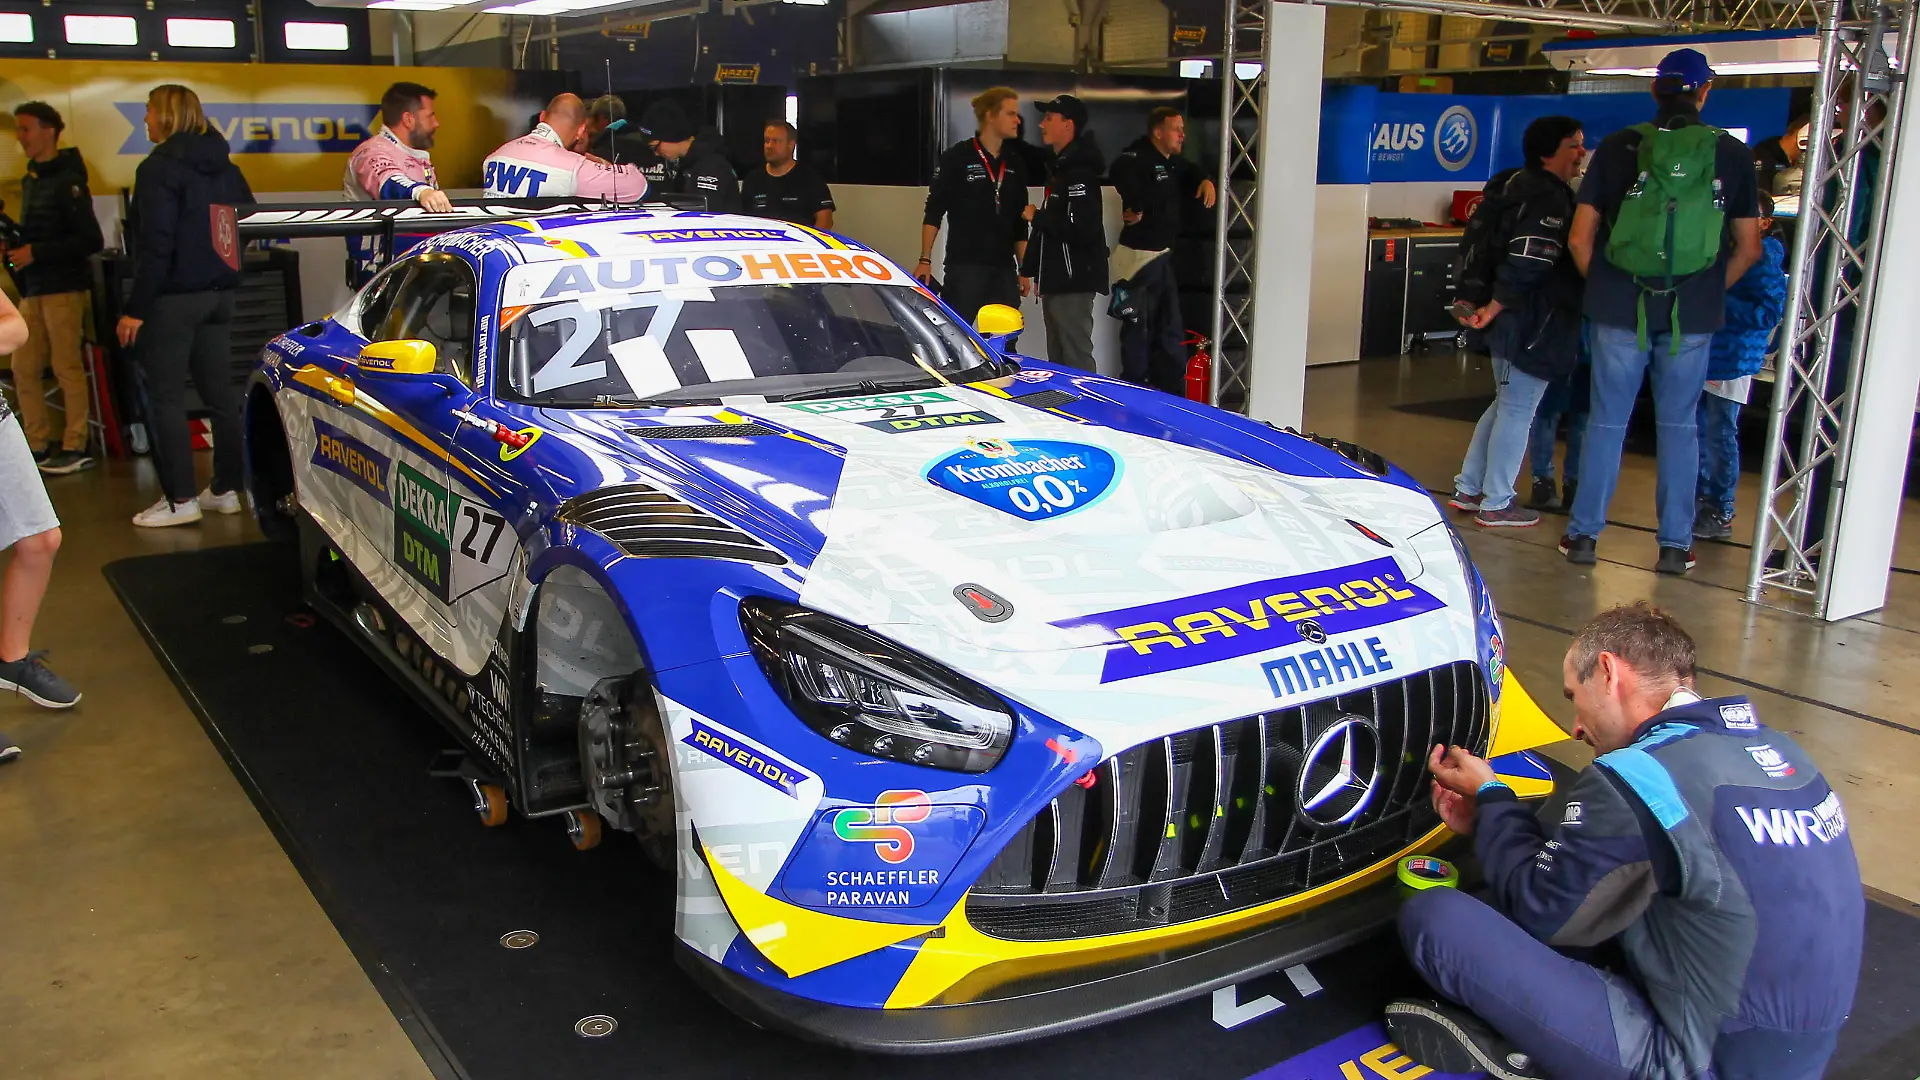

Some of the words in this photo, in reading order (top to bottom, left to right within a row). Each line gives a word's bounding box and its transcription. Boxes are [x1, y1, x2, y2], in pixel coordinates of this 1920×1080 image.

[206, 116, 361, 141] VENOL
[1372, 123, 1425, 151] AUS
[485, 161, 548, 198] BWT
[635, 231, 780, 241] RAVENOL
[540, 253, 893, 298] AUTOHERO
[527, 289, 685, 395] 27
[804, 392, 933, 413] DEKRA
[865, 404, 926, 419] 27
[888, 413, 985, 430] DTM
[320, 433, 386, 492] RAVENOL
[945, 454, 1088, 483] Krombacher
[399, 472, 450, 541] DEKRA
[460, 505, 506, 565] 27
[403, 530, 441, 586] DTM
[1116, 575, 1417, 656] RAVENOL
[1259, 636, 1394, 699] MAHLE
[694, 729, 791, 788] RAVENOL
[826, 870, 939, 887] SCHAEFFLER
[826, 890, 910, 905] PARAVAN
